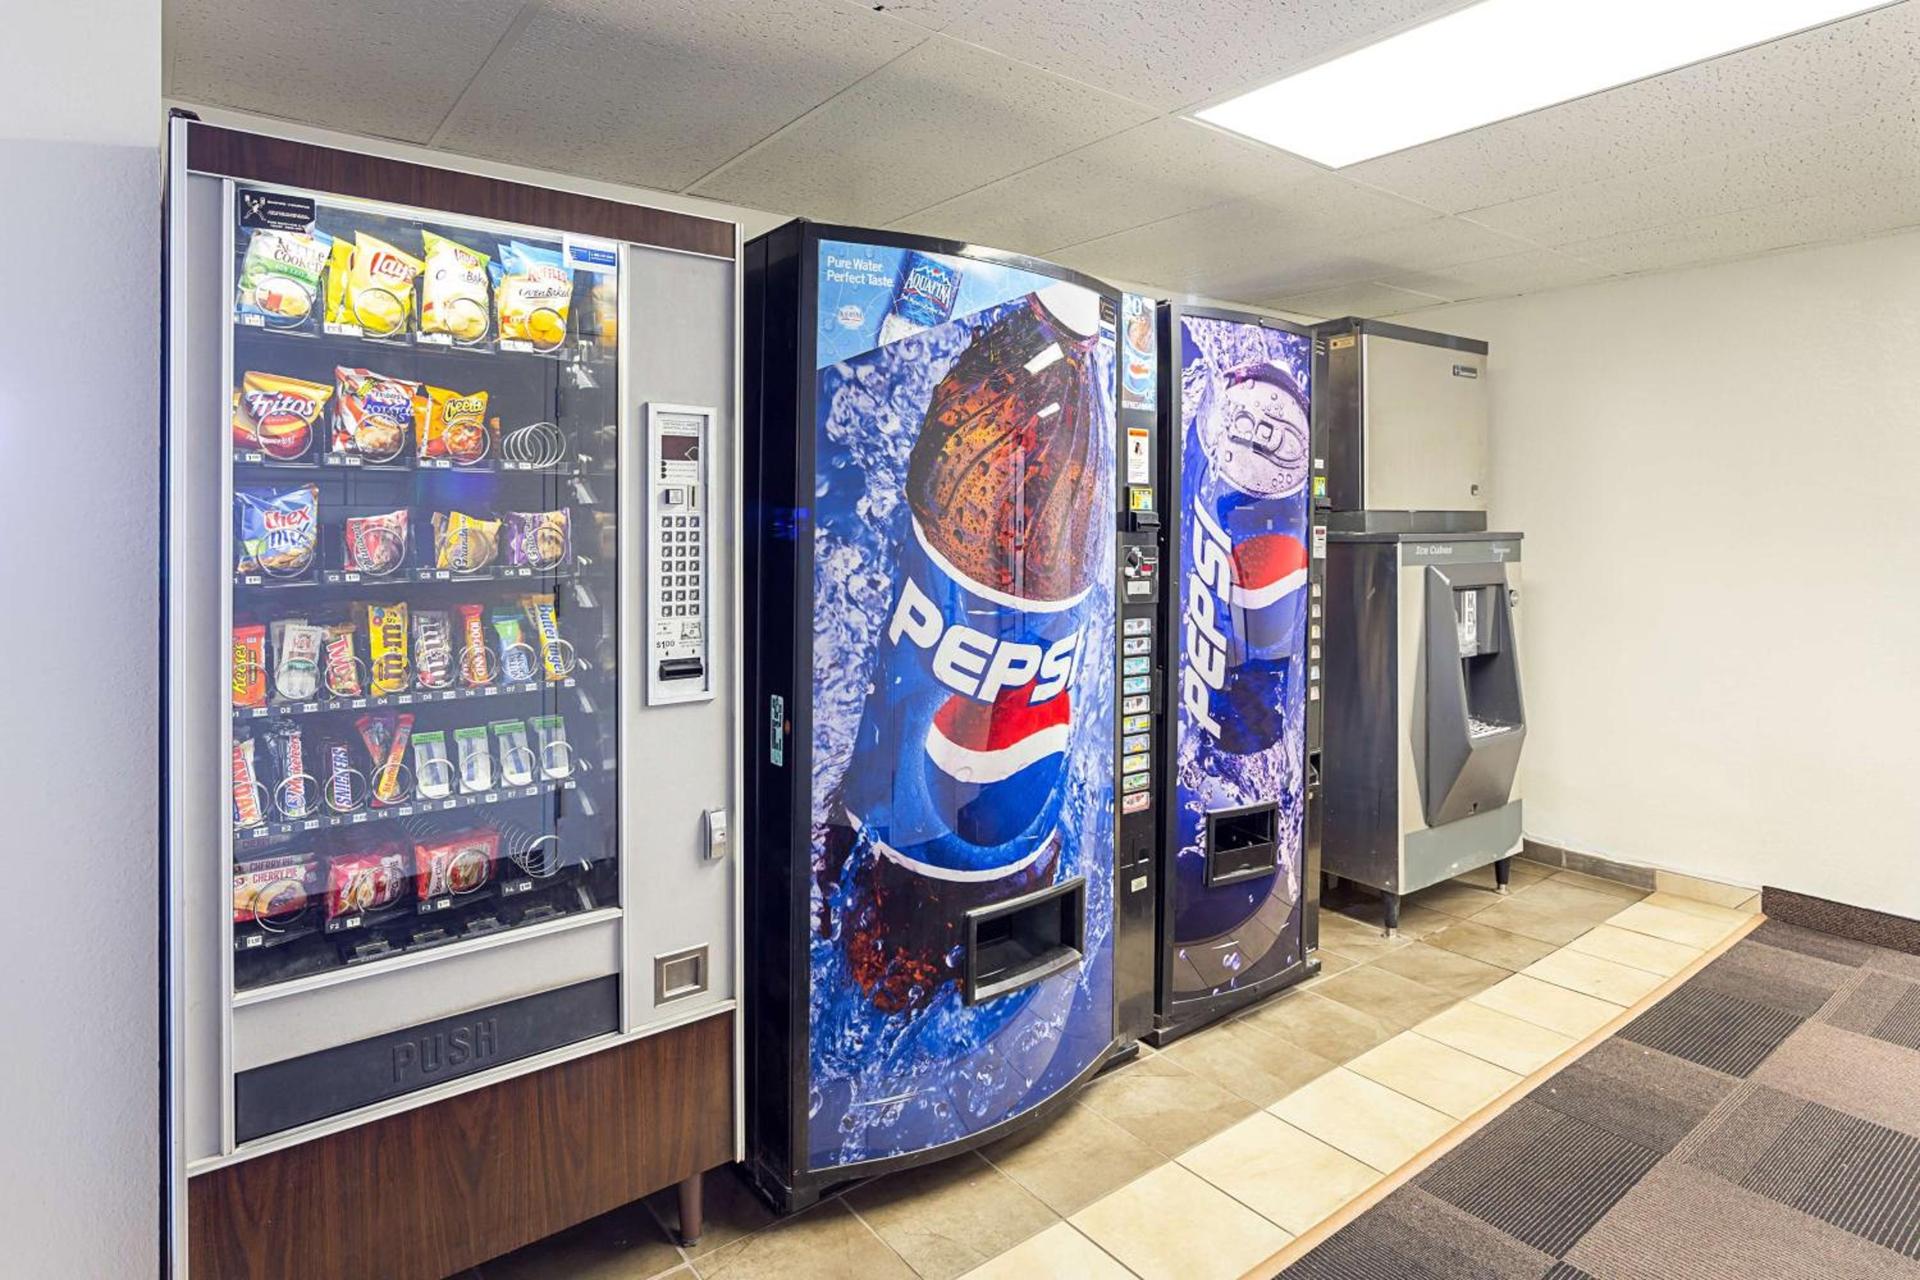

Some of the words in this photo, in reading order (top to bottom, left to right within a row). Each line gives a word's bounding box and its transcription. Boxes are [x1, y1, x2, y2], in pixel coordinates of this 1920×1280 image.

[827, 255, 852, 270] Pure
[827, 269, 866, 284] Perfect
[904, 272, 952, 306] AQUAFINA
[245, 391, 316, 418] Fritos
[263, 505, 310, 530] Chex
[1183, 497, 1233, 739] PEPSI
[888, 576, 1091, 704] PEPSI
[253, 869, 283, 884] CHERRY
[391, 1017, 498, 1084] PUSH
